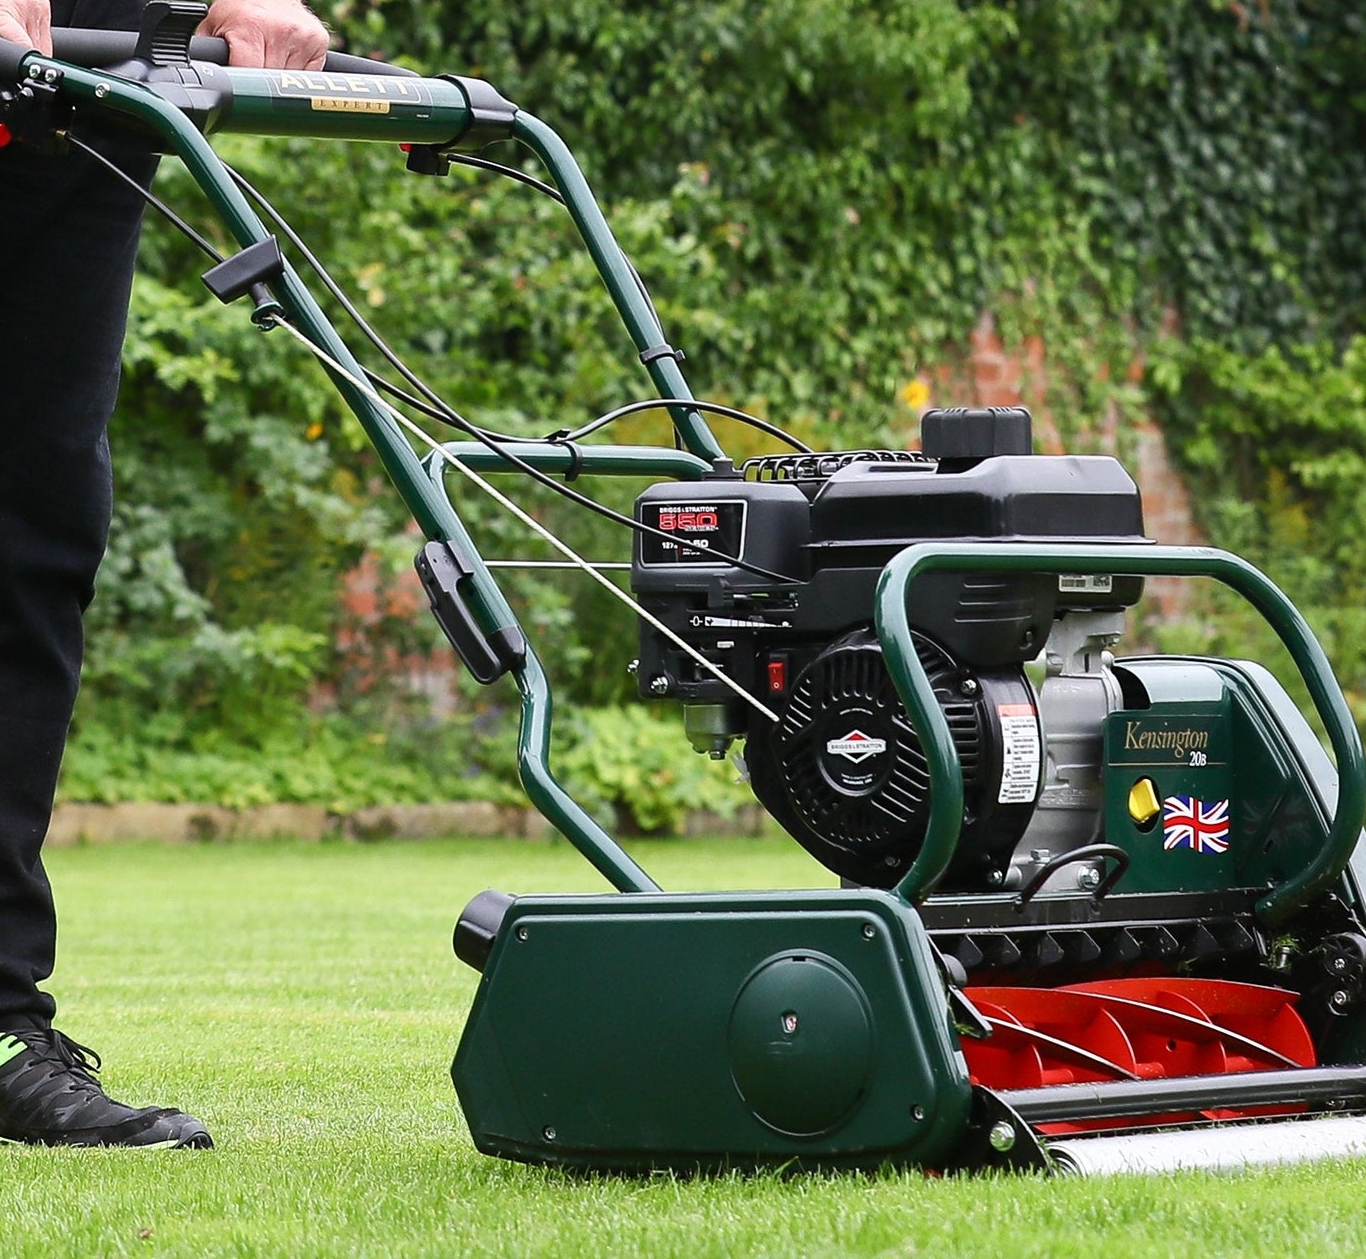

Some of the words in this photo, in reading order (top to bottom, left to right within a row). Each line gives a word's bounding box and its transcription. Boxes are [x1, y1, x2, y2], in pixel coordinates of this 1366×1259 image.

[281, 73, 409, 95] ALLETT
[320, 99, 383, 111] EXPERT
[659, 513, 718, 531] 550
[1124, 721, 1209, 758] Kensington
